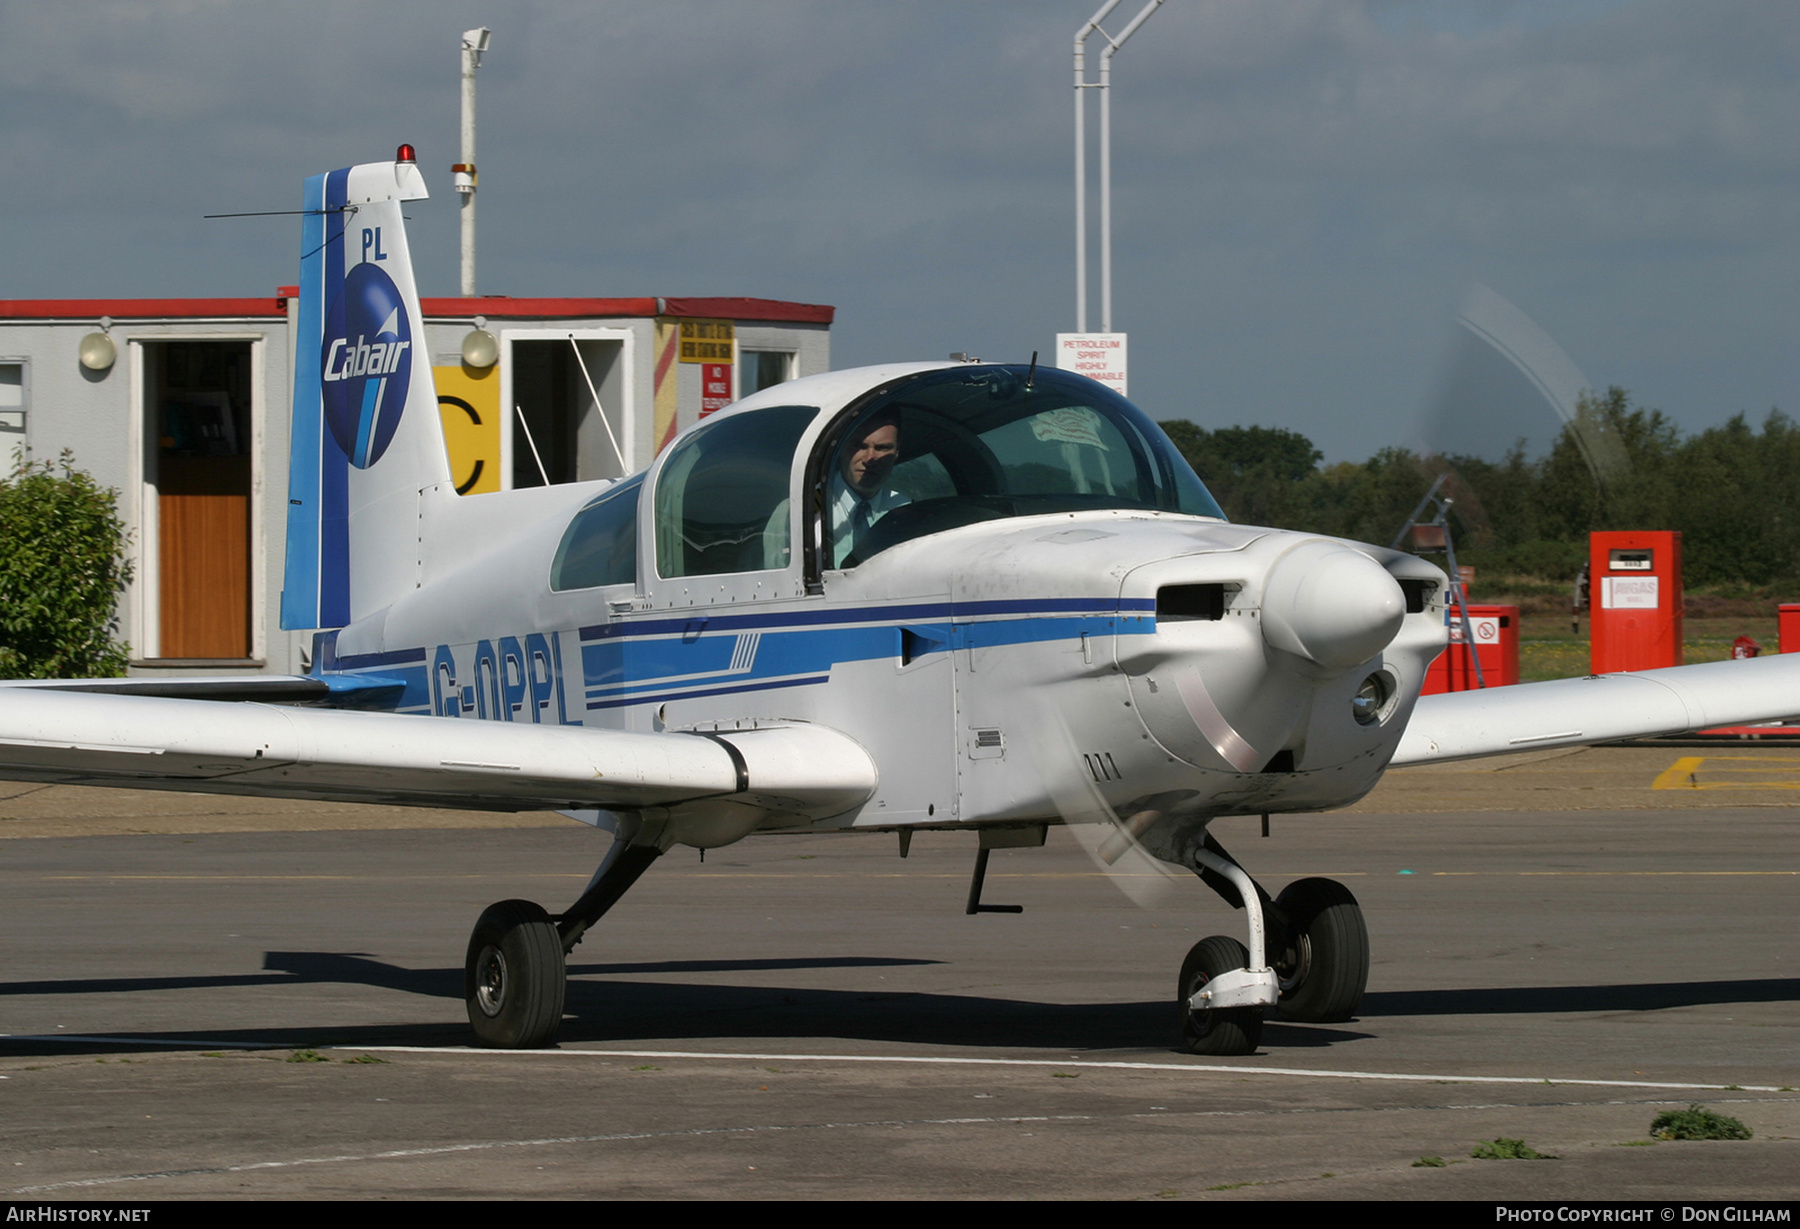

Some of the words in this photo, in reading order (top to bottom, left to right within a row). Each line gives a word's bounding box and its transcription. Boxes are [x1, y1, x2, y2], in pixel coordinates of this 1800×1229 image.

[362, 227, 387, 262] PL
[1063, 340, 1120, 348] PETROLEUM
[324, 334, 410, 382] Cabair
[1077, 351, 1106, 359] SPIRIT
[1075, 361, 1107, 369] HIGHLY
[1614, 581, 1656, 595] AVGAS
